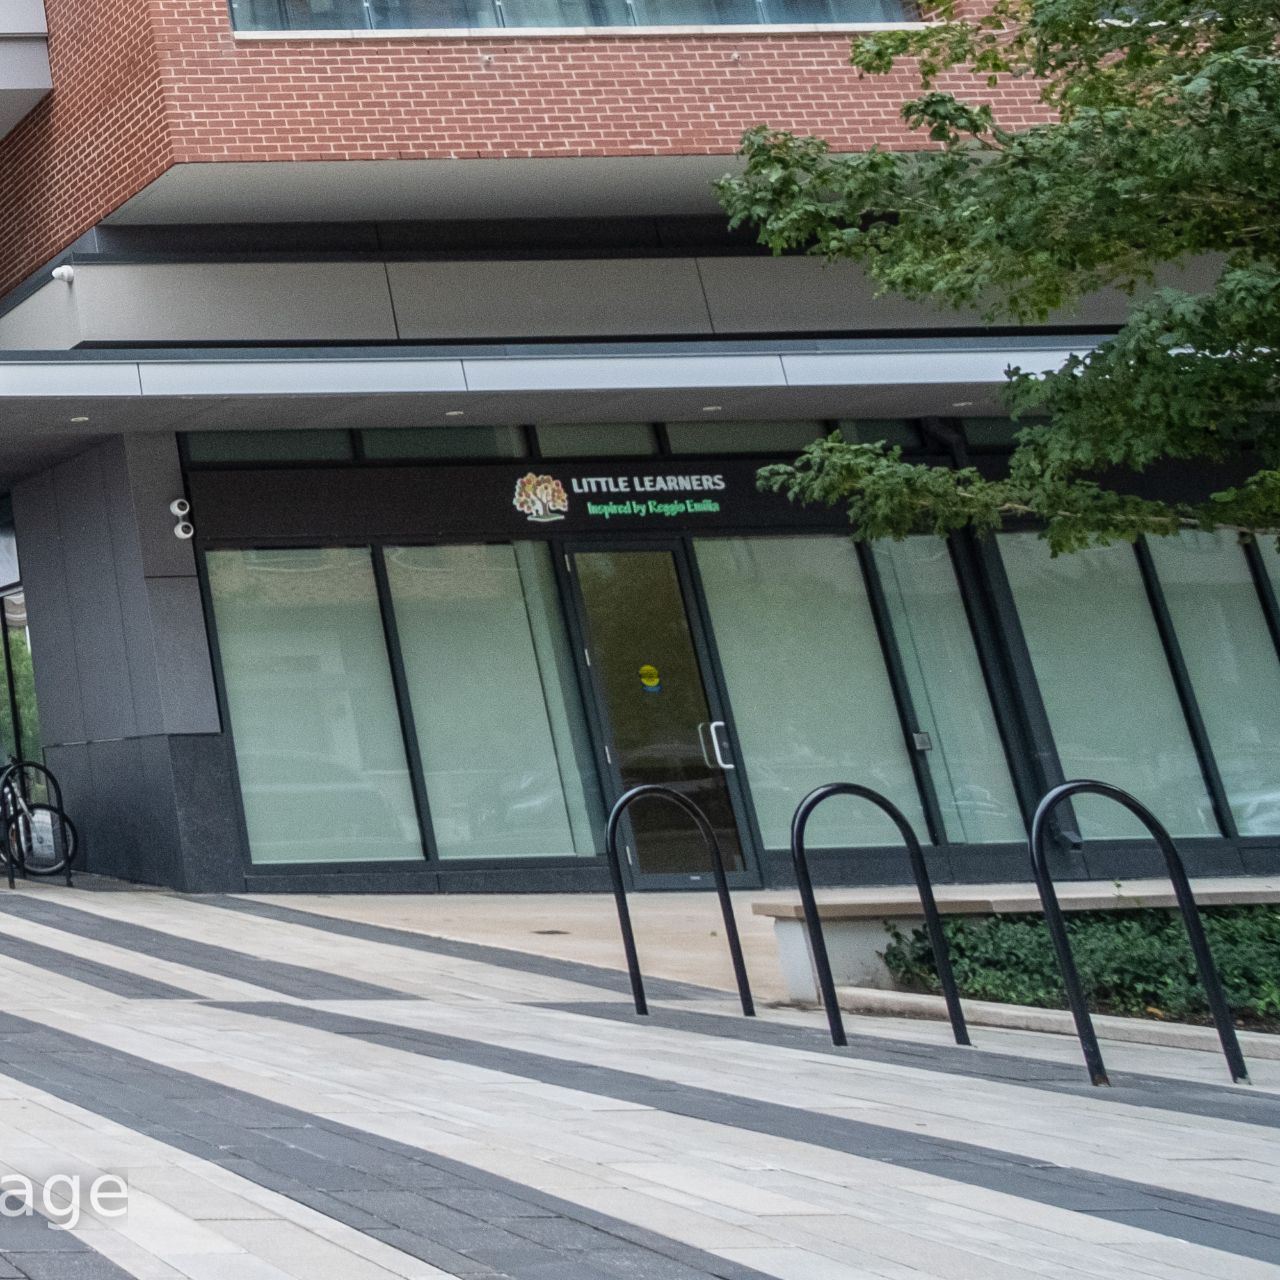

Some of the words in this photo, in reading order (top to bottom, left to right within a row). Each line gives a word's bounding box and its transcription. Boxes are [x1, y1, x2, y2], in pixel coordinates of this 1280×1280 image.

[571, 477, 631, 493] LITTLE
[633, 474, 726, 492] LEARNERS
[587, 501, 631, 519] Inspired
[632, 500, 647, 516] by
[647, 499, 685, 517] Reggio
[685, 498, 721, 513] Emilia
